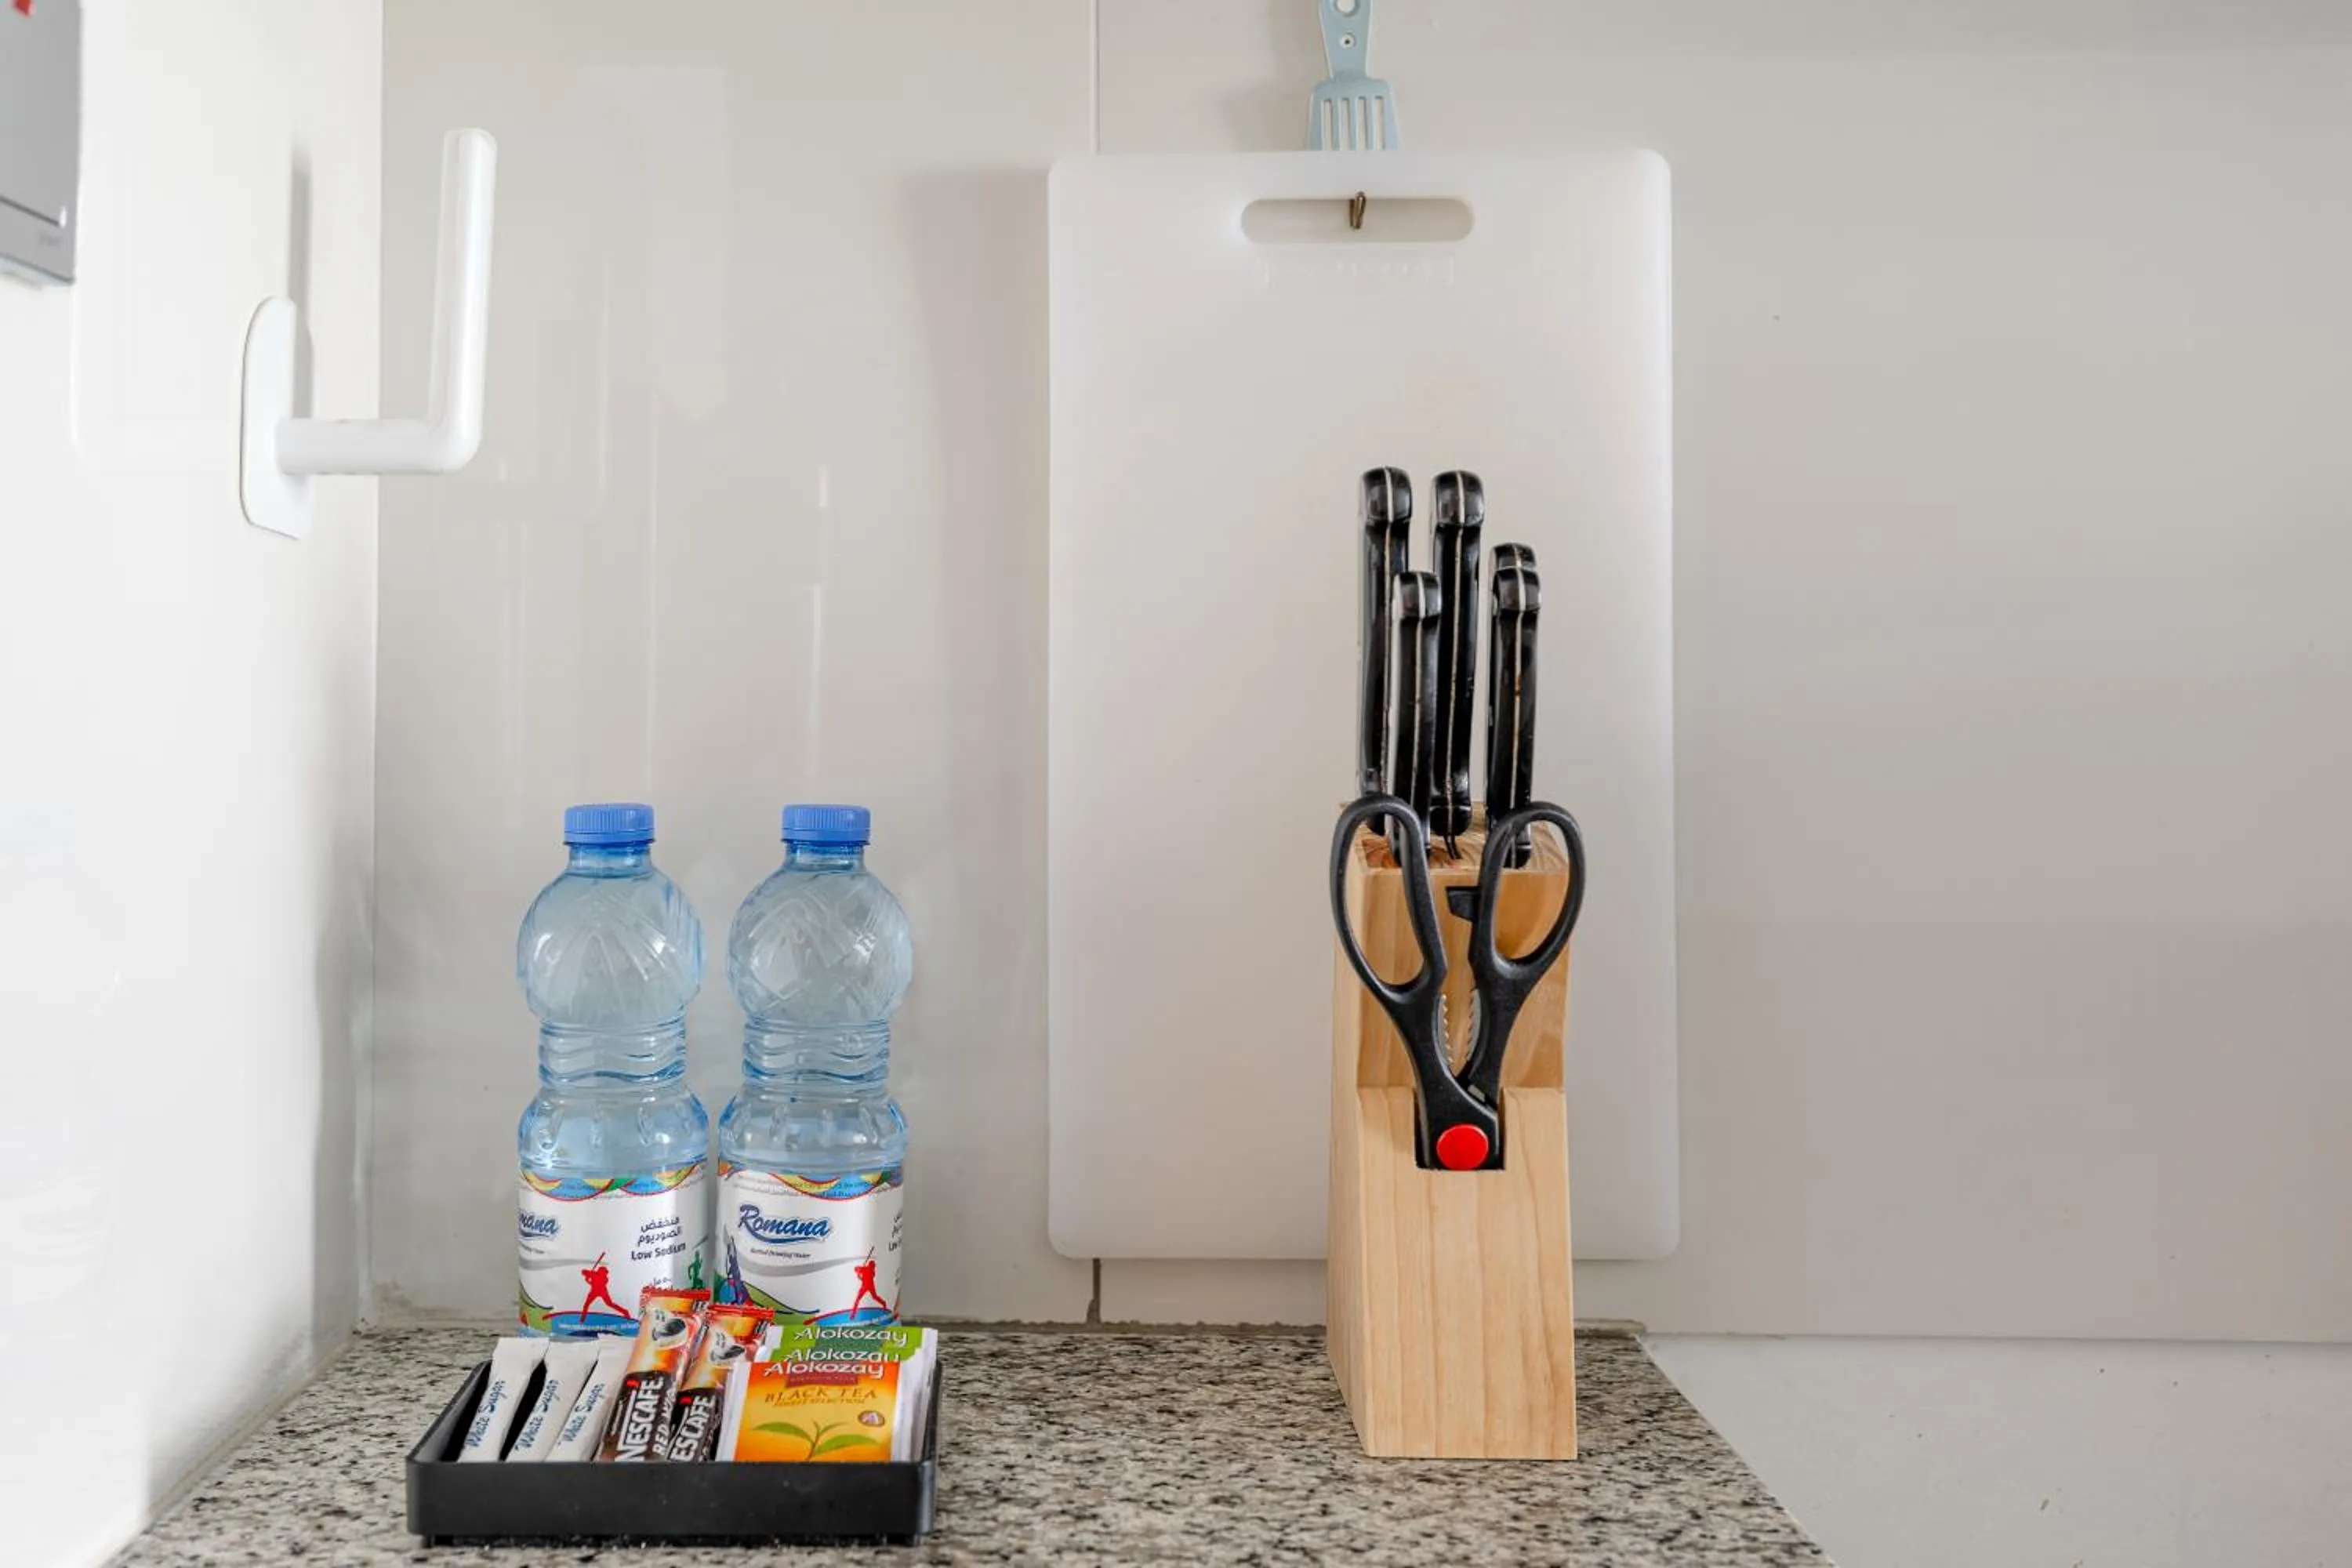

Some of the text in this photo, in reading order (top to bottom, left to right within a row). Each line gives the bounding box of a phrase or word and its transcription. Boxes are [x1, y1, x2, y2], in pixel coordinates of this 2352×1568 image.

[519, 1213, 559, 1237] ana
[738, 1203, 832, 1243] Romana
[631, 1250, 652, 1261] Low
[794, 1327, 907, 1348] Alokozay
[764, 1361, 885, 1380] Alokozay
[477, 1380, 507, 1414] Sugar
[535, 1379, 561, 1414] Sugar
[765, 1387, 829, 1403] BLACK
[840, 1388, 877, 1399] TEA
